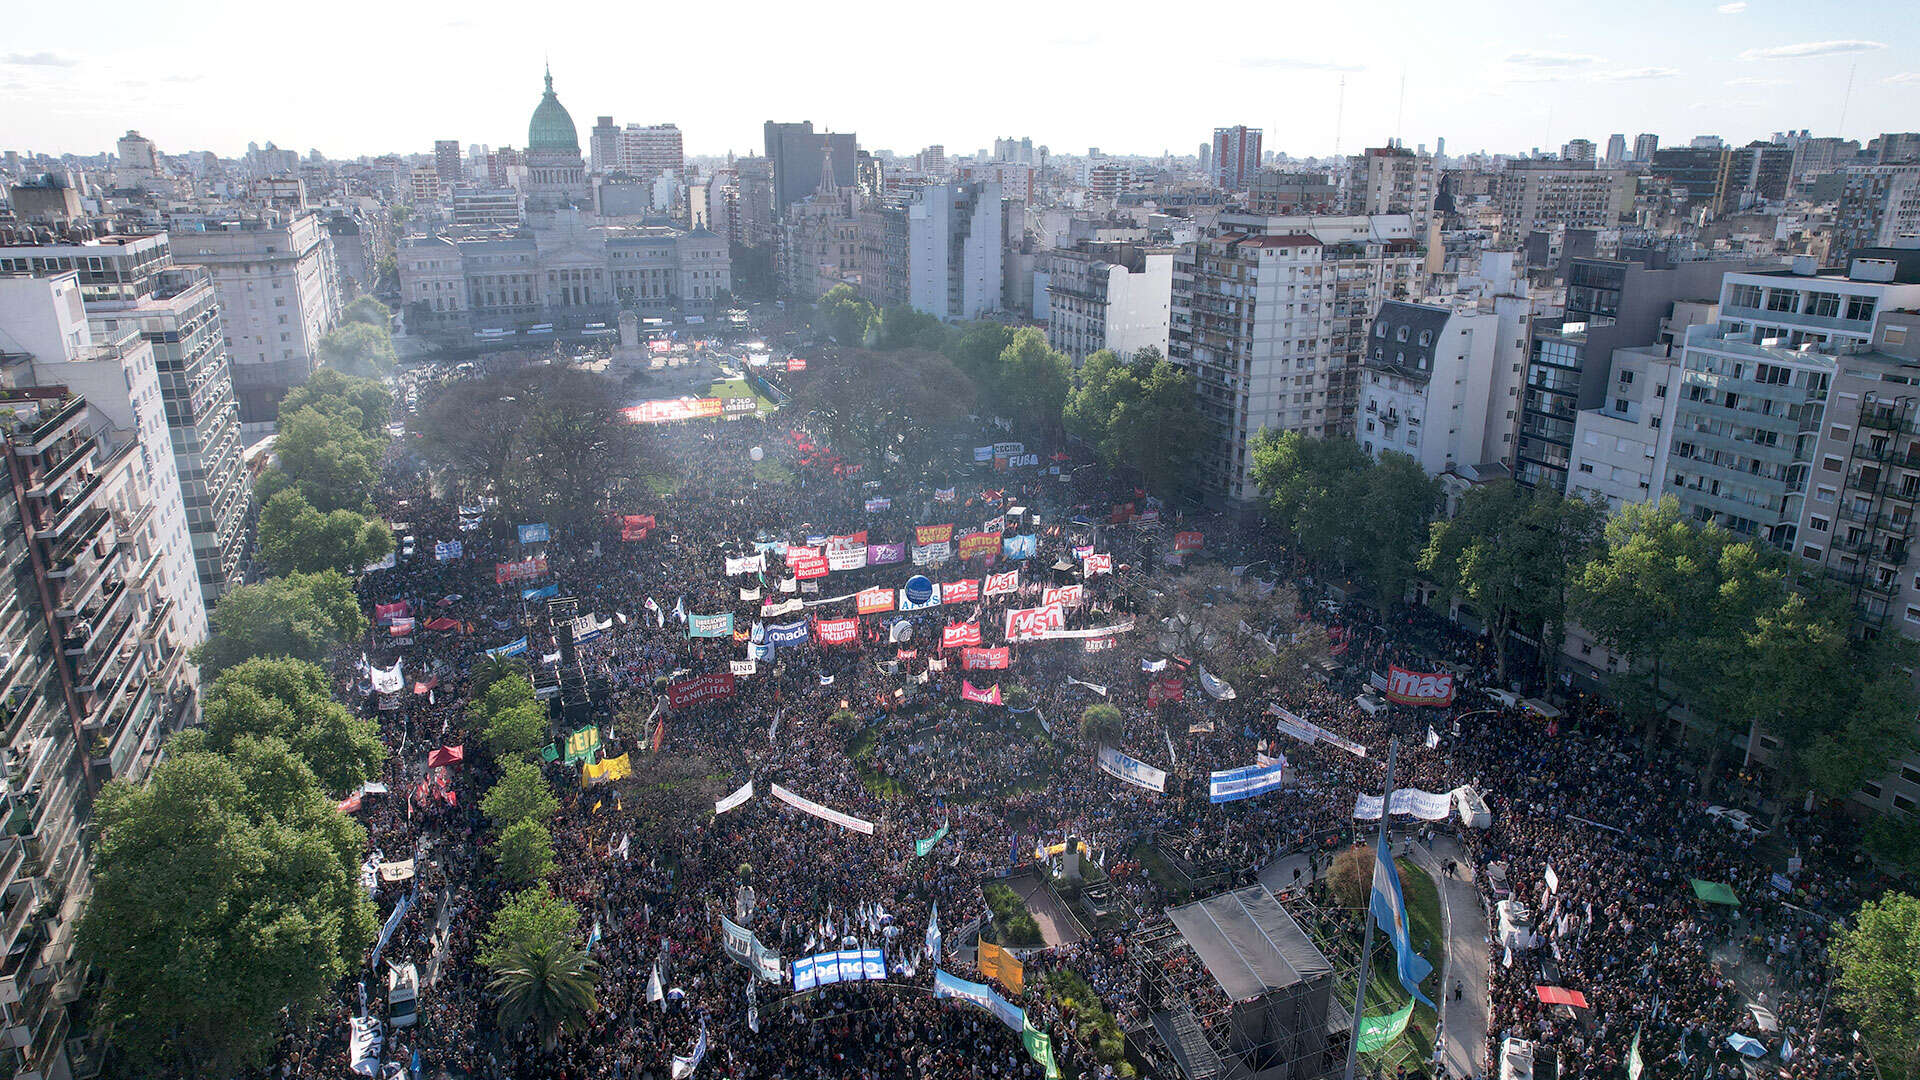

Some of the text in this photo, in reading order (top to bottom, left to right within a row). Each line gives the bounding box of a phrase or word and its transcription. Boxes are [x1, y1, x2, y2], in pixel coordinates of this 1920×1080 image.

[1009, 455, 1039, 468] FUBA
[917, 526, 953, 537] PARTIDO
[960, 536, 1000, 549] PARTIDO
[943, 582, 968, 595] PTS
[989, 573, 1016, 589] MST
[858, 591, 894, 608] mas
[1049, 586, 1079, 604] MST
[1014, 607, 1060, 634] MST
[821, 629, 856, 641] SOCIALISTA
[944, 624, 968, 639] PTS
[678, 677, 725, 693] SINDICATO DE
[1389, 670, 1451, 698] mas
[675, 685, 731, 704] CANILLITAS
